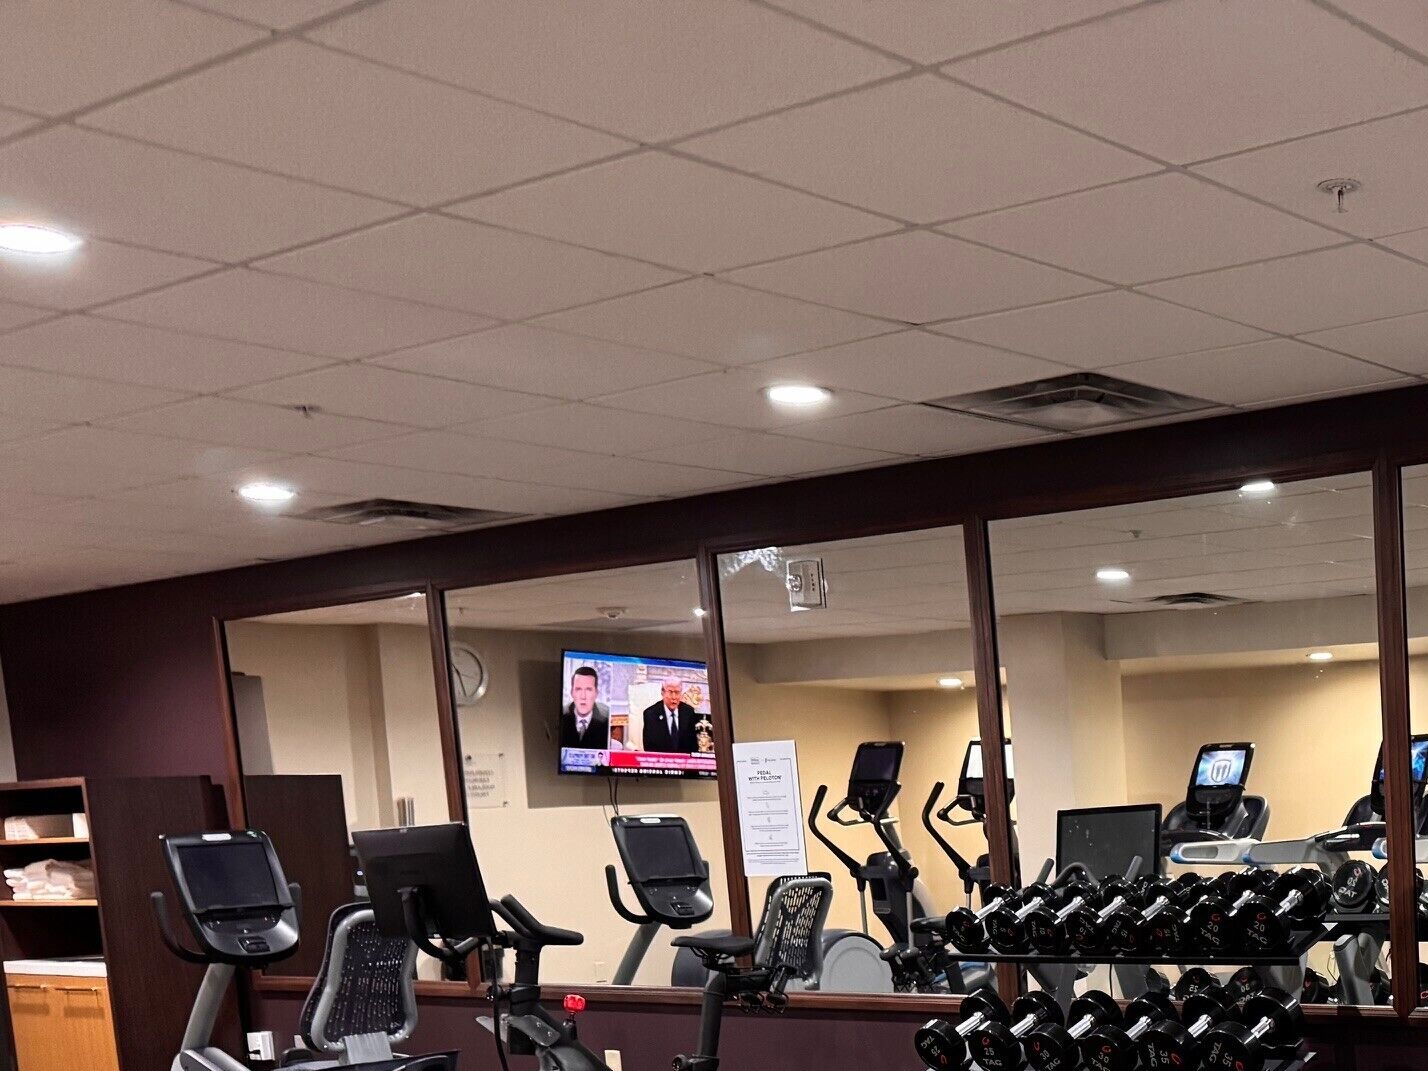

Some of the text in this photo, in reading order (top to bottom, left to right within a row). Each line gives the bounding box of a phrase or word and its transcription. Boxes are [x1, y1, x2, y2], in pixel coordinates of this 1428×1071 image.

[1207, 921, 1219, 933] 20
[1254, 921, 1266, 933] 20
[1200, 928, 1220, 946] TAG
[1246, 928, 1268, 946] TAG
[984, 1047, 995, 1056] 25
[1040, 1049, 1050, 1061] 30
[1147, 1042, 1158, 1069] TAG
[1159, 1050, 1169, 1065] 35
[1209, 1042, 1222, 1064] TAG
[983, 1058, 1003, 1067] TAG
[1222, 1052, 1233, 1068] 35
